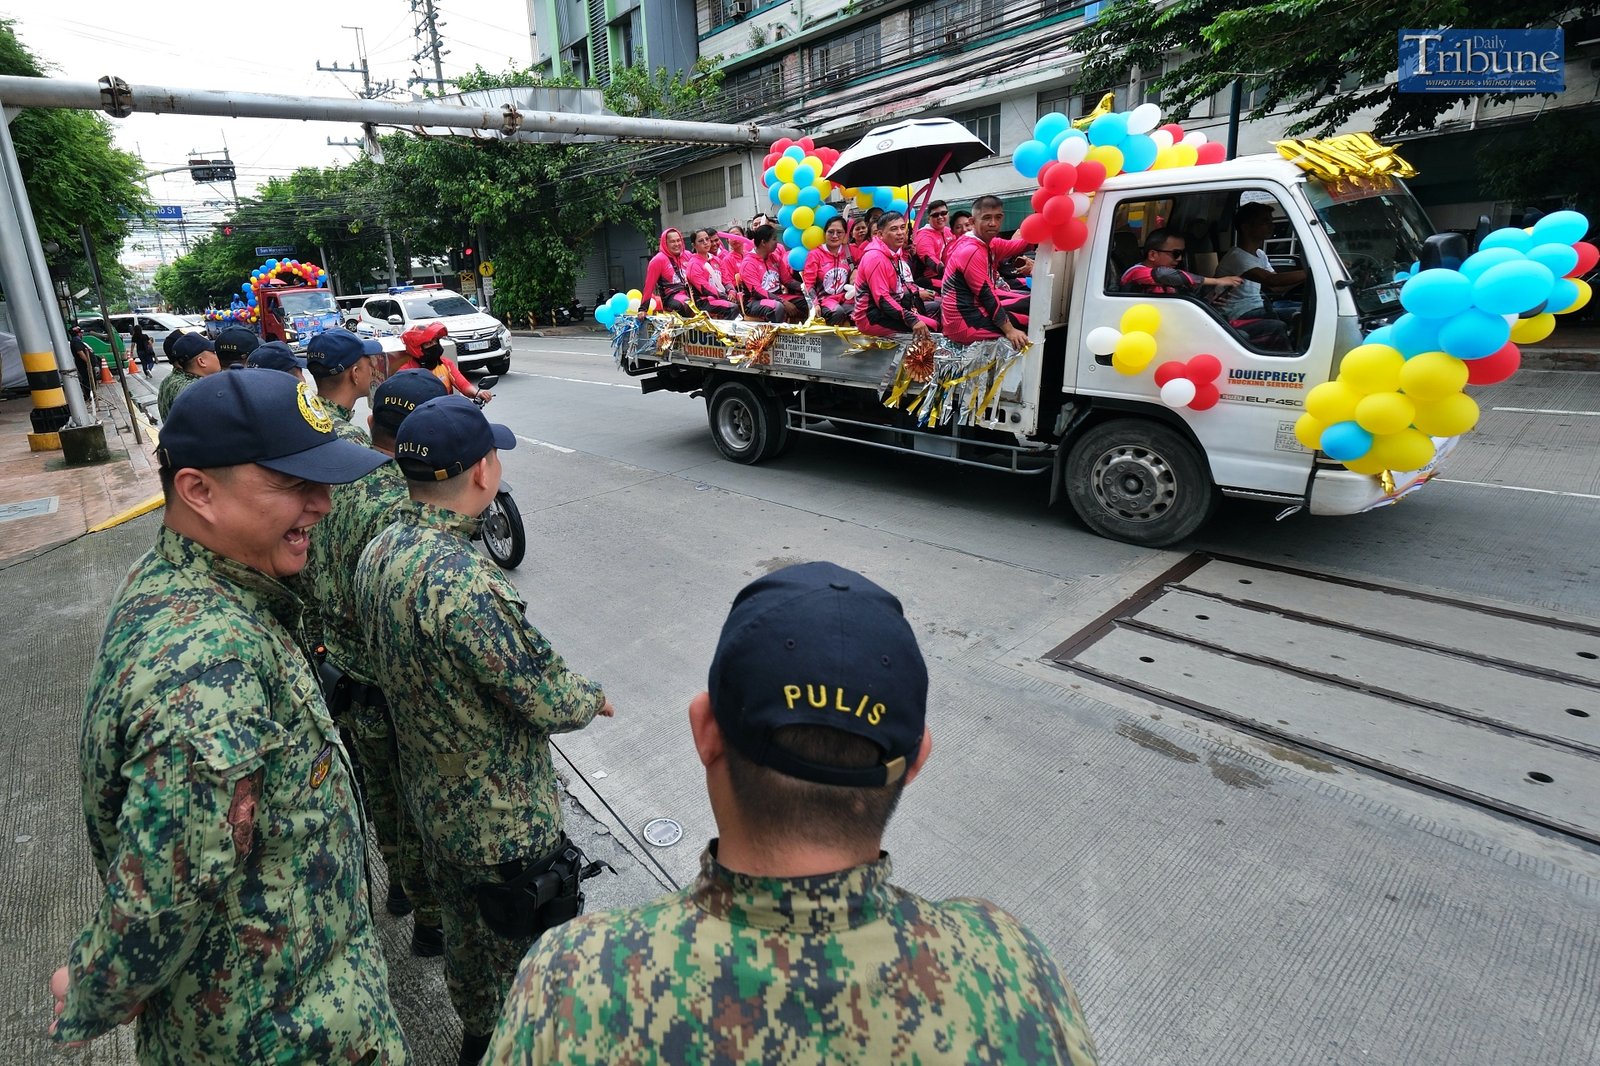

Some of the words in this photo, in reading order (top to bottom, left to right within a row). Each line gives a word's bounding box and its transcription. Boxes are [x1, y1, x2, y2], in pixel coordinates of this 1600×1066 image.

[167, 206, 176, 214] St
[1229, 369, 1306, 383] LOUIEPRECY
[1228, 378, 1265, 386] TRUCKING
[1266, 381, 1304, 389] SERVICES
[384, 396, 416, 411] PULIS
[398, 442, 429, 457] PULIS
[783, 684, 886, 726] PULIS
